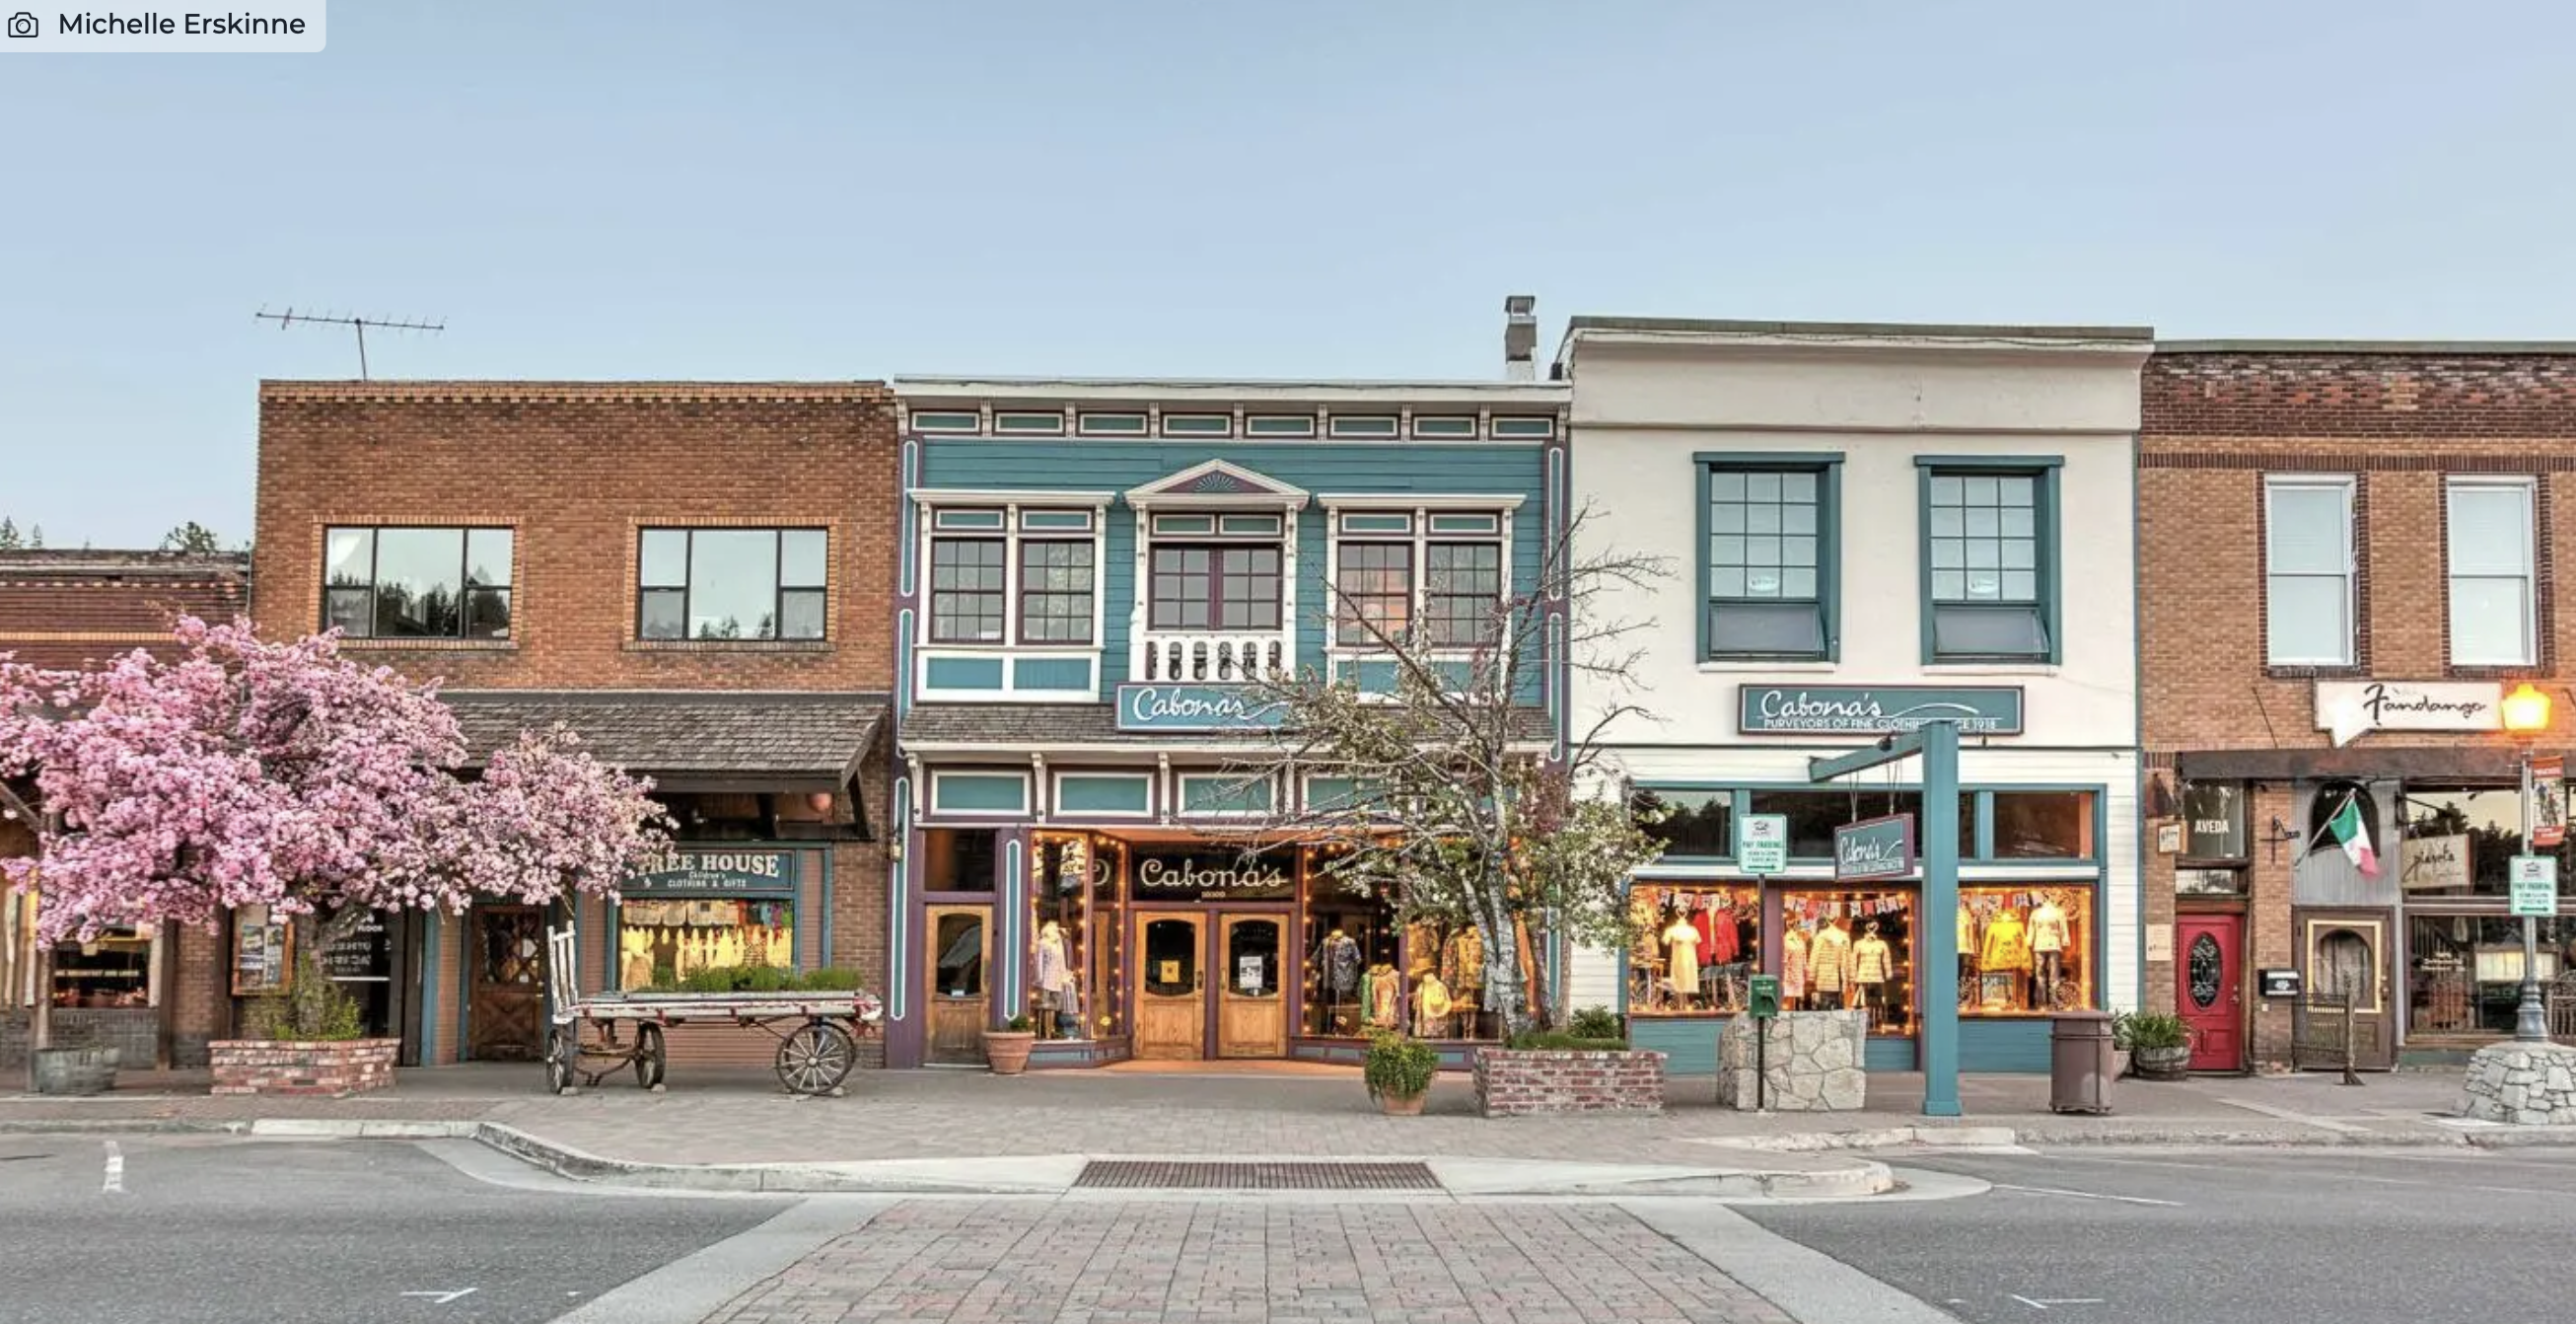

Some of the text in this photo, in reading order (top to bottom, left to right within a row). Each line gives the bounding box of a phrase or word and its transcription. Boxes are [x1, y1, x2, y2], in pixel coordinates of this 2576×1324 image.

[1760, 690, 1883, 717] Cabona's
[2363, 683, 2486, 725] Fandango
[1763, 718, 1831, 729] PURVEYORS
[1832, 718, 1850, 729] OF
[1851, 718, 1874, 729] FINE
[2194, 819, 2230, 835] AVEDA
[701, 853, 780, 878] HOUSE
[1139, 857, 1290, 888] Cabona's
[667, 878, 748, 888] CLOTHING & GIFTS
